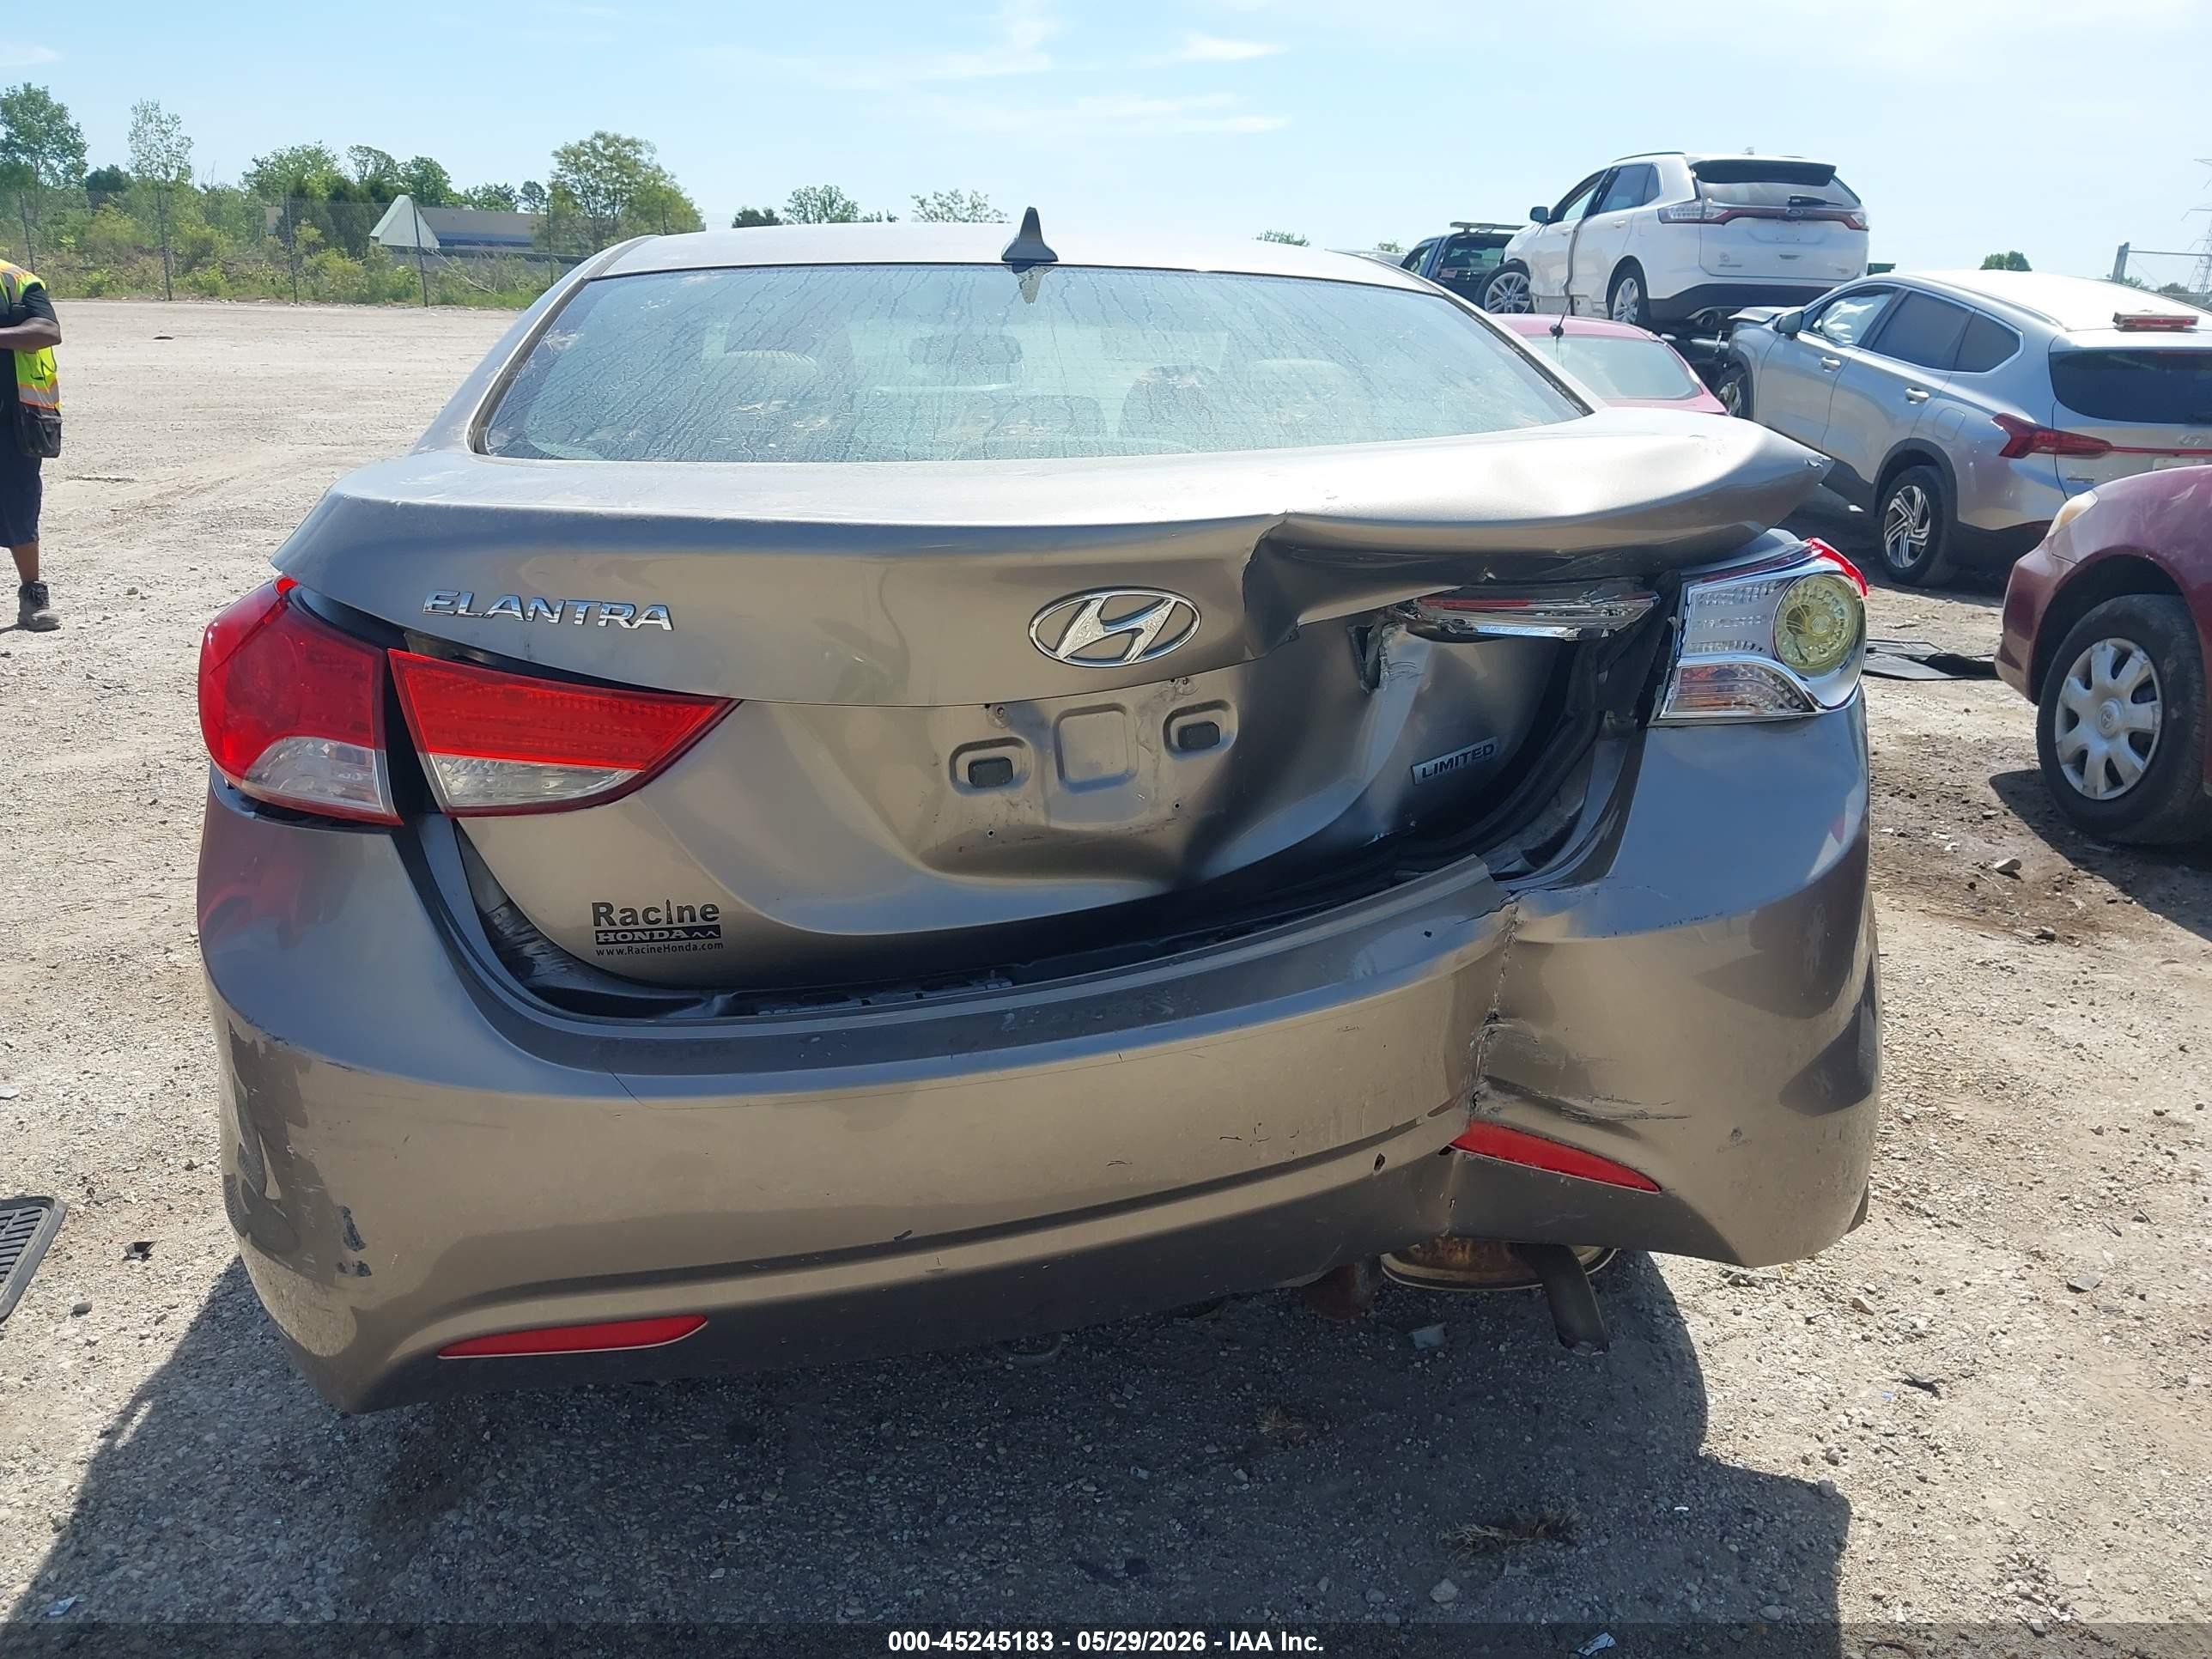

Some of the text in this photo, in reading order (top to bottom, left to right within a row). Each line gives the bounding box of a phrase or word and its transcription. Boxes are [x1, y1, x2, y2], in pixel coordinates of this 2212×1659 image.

[422, 589, 674, 631] ELANTRA
[1421, 744, 1494, 778] LIMITED
[591, 899, 720, 927] Racine
[596, 928, 690, 943] HONDA
[596, 941, 724, 957] www.RacineHonda.com
